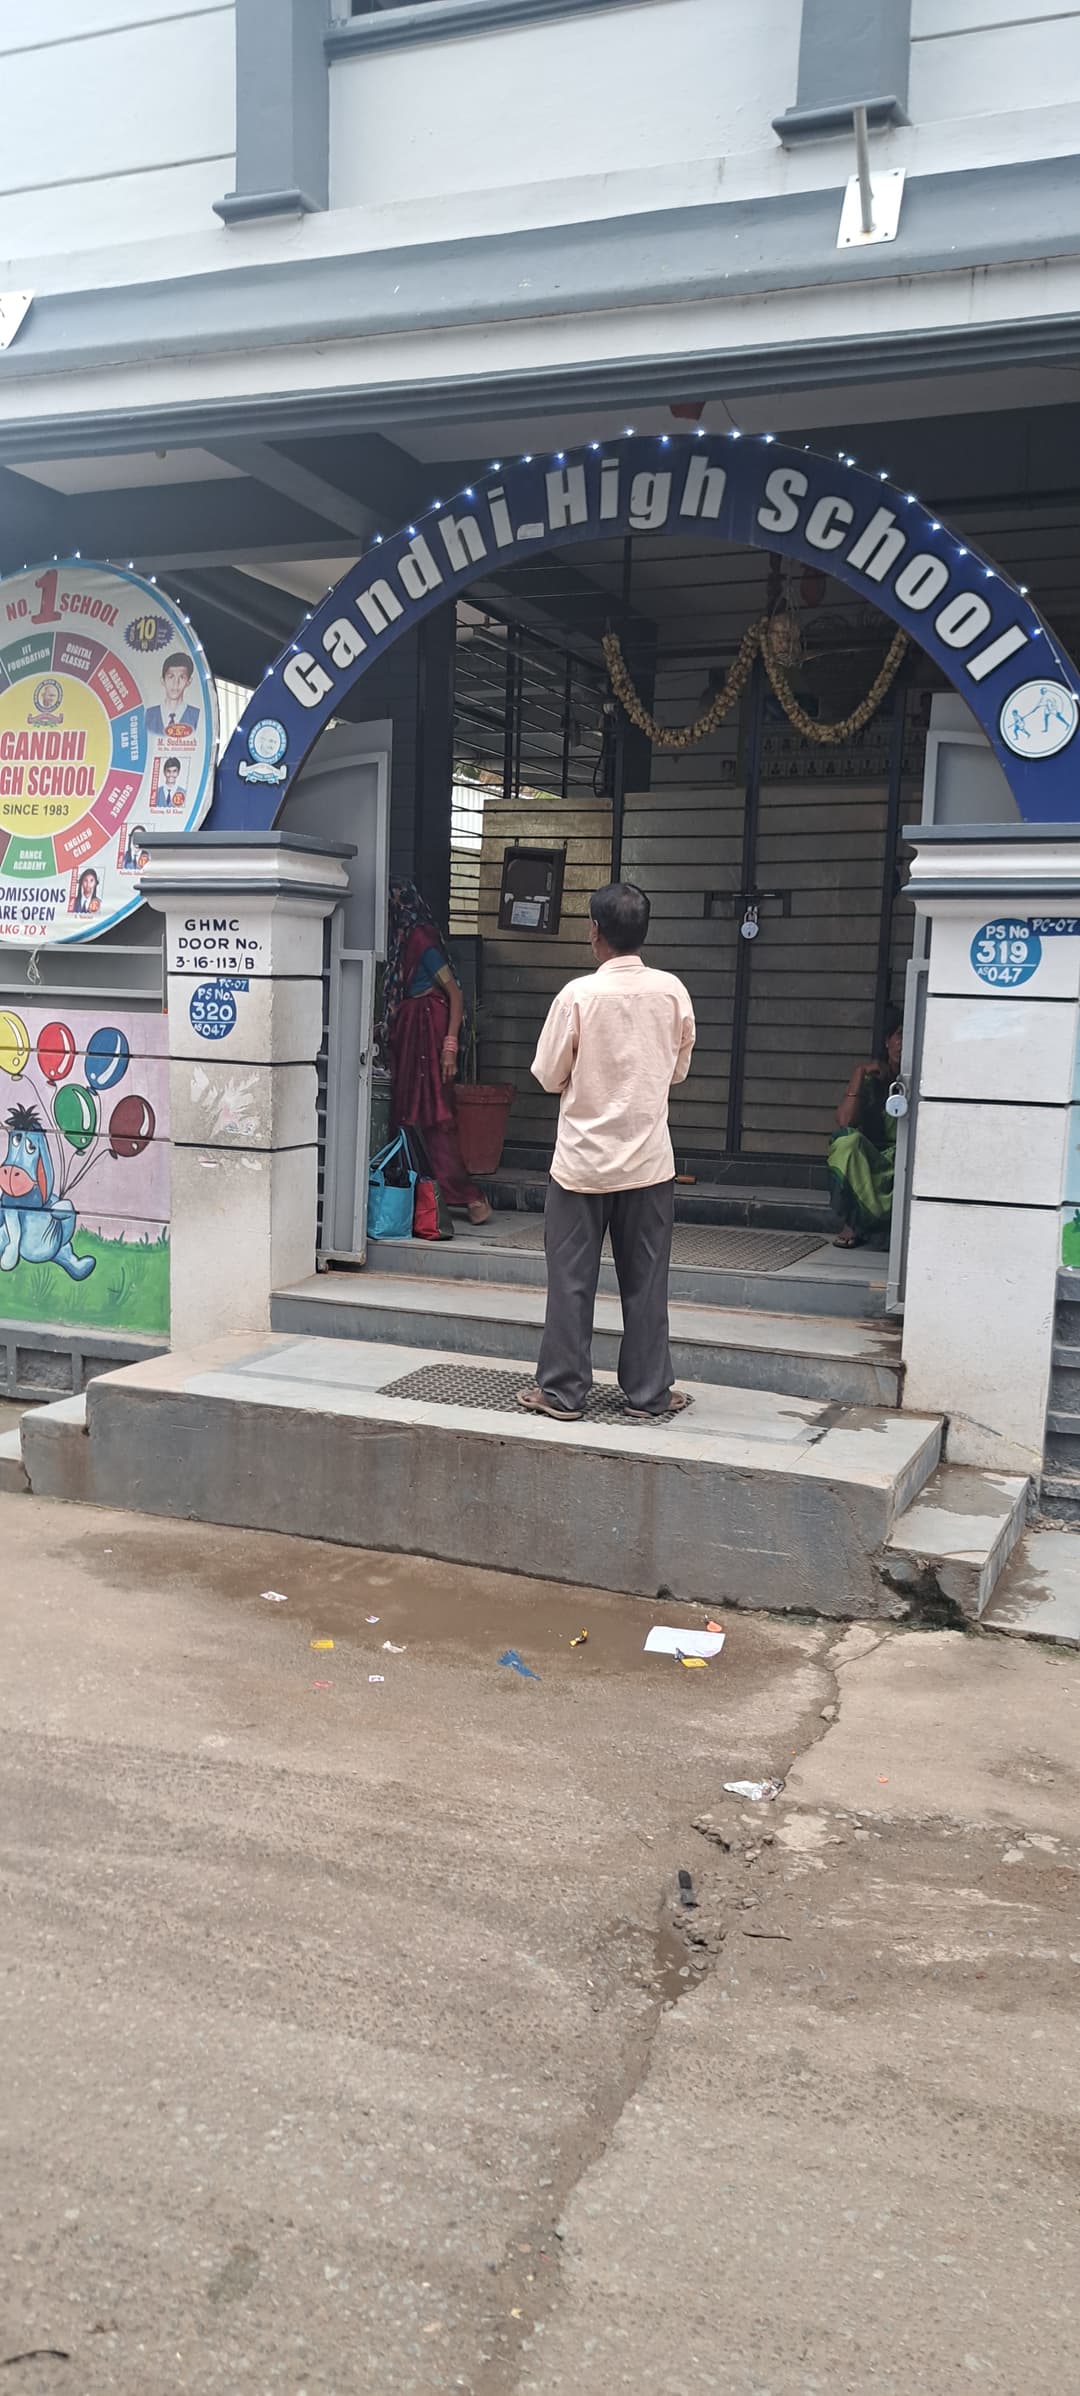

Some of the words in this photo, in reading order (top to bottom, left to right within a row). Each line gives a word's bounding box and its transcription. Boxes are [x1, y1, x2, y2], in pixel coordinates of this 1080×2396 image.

[282, 486, 514, 709] Gandhi
[546, 455, 727, 530] High
[757, 467, 1029, 682] School
[6, 598, 31, 621] NO.
[31, 569, 62, 625] 1
[60, 593, 119, 627] SCHOOL
[65, 642, 93, 660] DIGITAL
[7, 647, 51, 673] FOUNDATION
[60, 652, 91, 671] CLASSES
[0, 731, 86, 761] GANDHI
[121, 732, 129, 748] LAB
[130, 715, 139, 761] COMPUTER
[0, 765, 24, 795] GH
[27, 765, 96, 796] SCHOOL
[107, 787, 122, 804] LAB
[110, 784, 134, 818] SCIENCE
[3, 804, 39, 815] SINCE
[43, 804, 69, 816] 1983
[63, 827, 93, 852] ENGLISH
[19, 849, 43, 860] DANCE
[72, 841, 92, 858] CLUB
[13, 860, 47, 871] ACADEMY
[22, 906, 55, 921] OPEN
[24, 925, 38, 935] TO
[39, 925, 47, 935] X
[184, 919, 240, 931] GHMC
[986, 925, 1006, 939] PS
[1009, 925, 1029, 939] No
[1032, 918, 1077, 932] PC-07
[178, 938, 229, 950] DOOR
[976, 940, 1028, 964] 319
[175, 953, 255, 972] 3-16-113/B
[198, 988, 212, 1000] PS
[192, 1001, 233, 1020] 320
